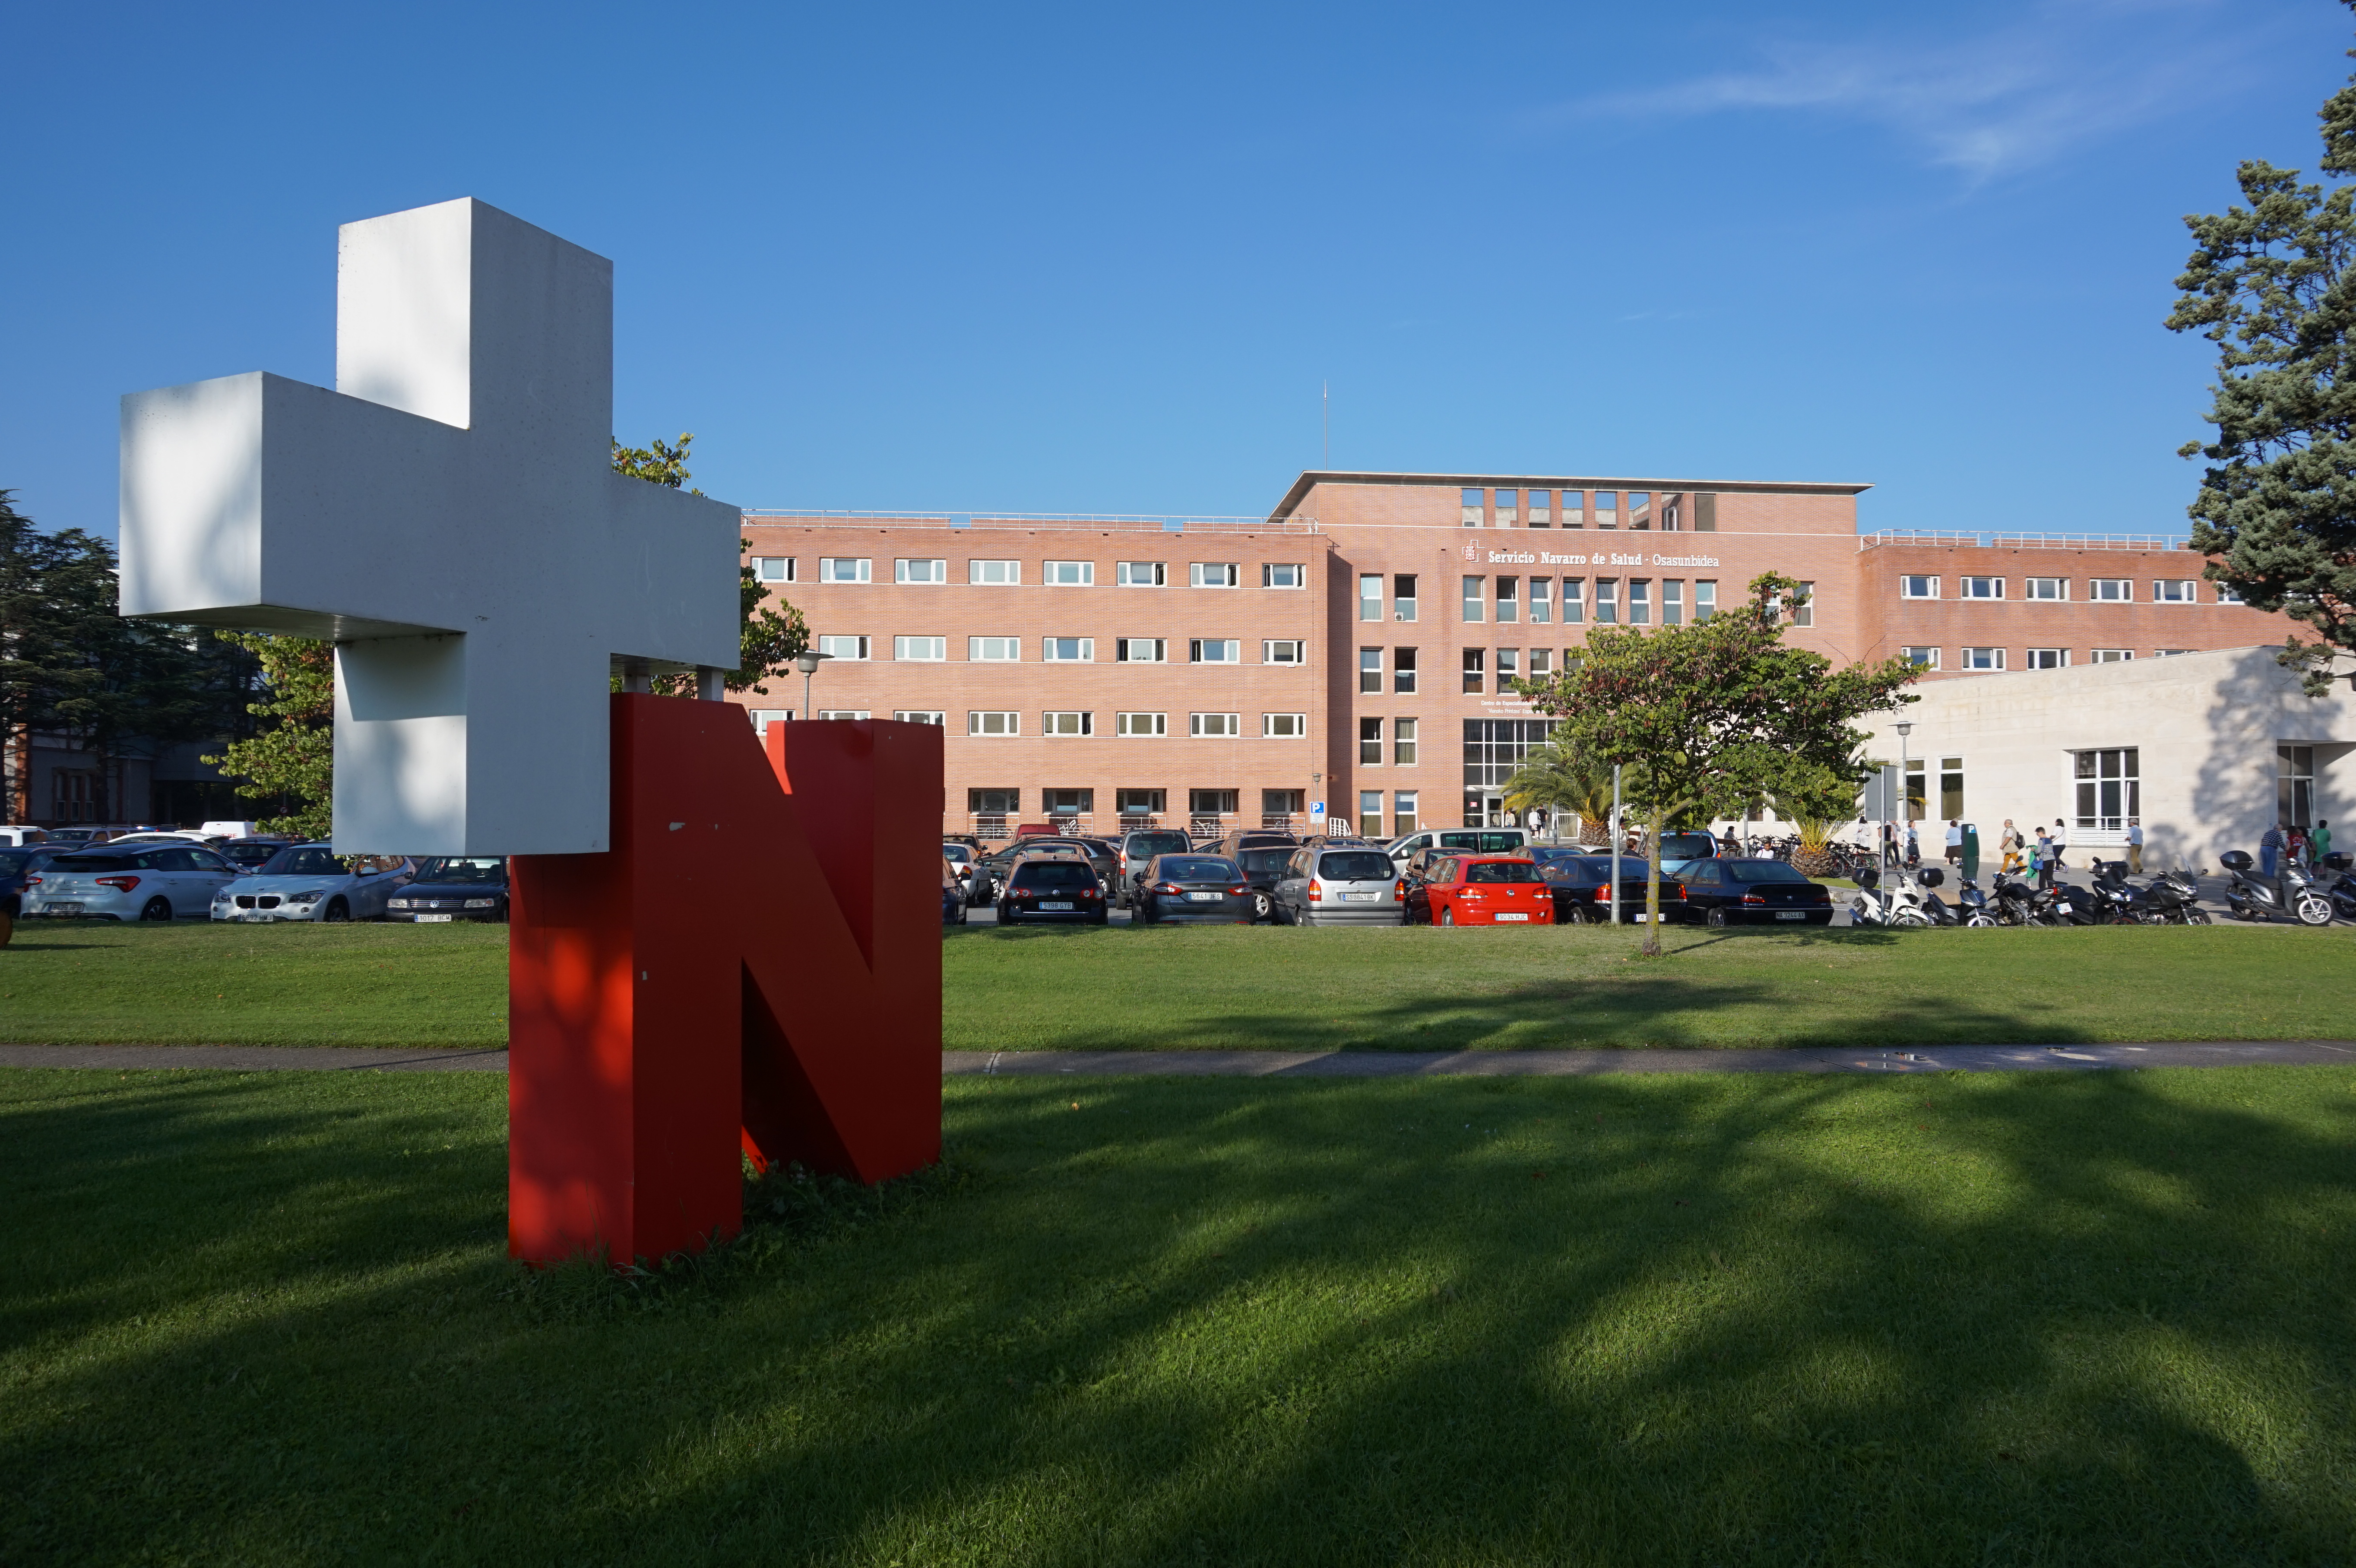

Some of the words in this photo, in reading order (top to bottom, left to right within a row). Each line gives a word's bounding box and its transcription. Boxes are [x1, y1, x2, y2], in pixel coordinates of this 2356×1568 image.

[1488, 550, 1535, 563] Servicio
[1541, 552, 1586, 564] Navarro
[1592, 553, 1606, 565] de
[1611, 553, 1642, 566] Salud
[1653, 553, 1720, 567] Osasunbidea
[1312, 803, 1320, 812] P
